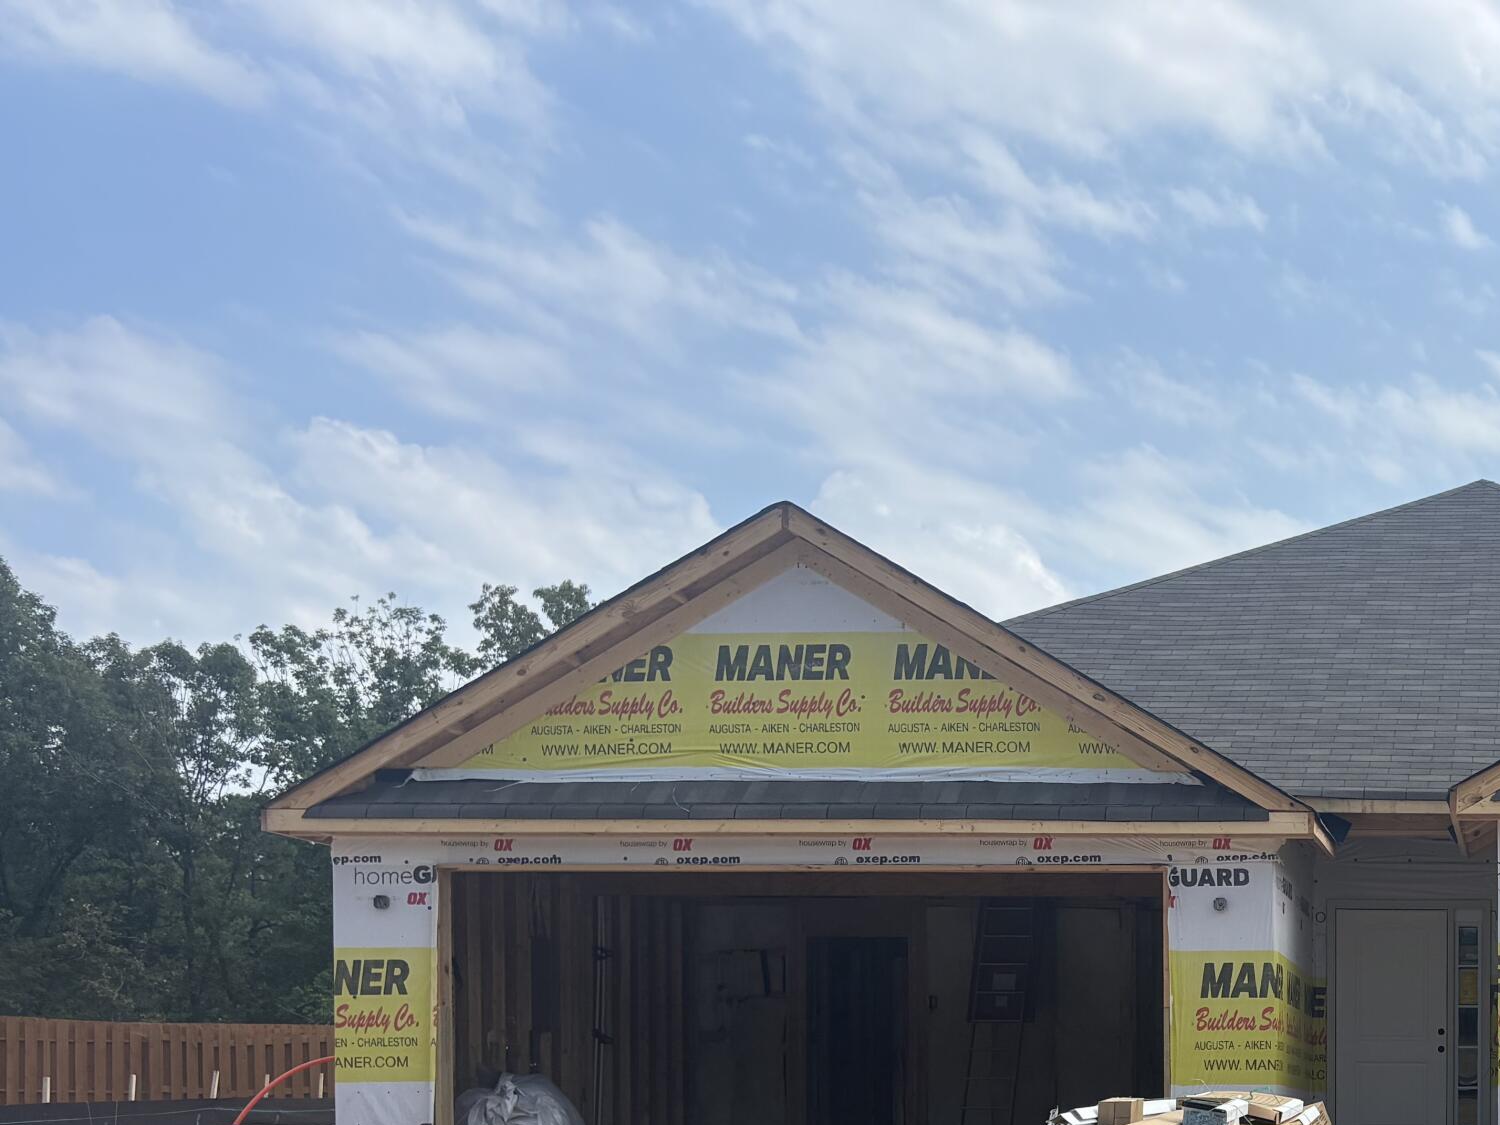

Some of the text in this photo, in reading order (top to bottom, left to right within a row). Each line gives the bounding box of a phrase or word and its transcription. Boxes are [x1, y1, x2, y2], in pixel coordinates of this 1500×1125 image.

[714, 643, 851, 682] MANER
[893, 643, 1000, 681] MAN
[598, 689, 683, 721] Supply Co.
[710, 688, 862, 720] Builders Supply Co.
[889, 688, 953, 714] Builders
[956, 688, 1012, 719] Supply
[530, 723, 681, 736] AUGUSTA AIKEN CHARLESTON
[709, 722, 860, 734] AUGUSTA AIKEN CHARLESTON
[888, 721, 1041, 733] AUGUSTA AIKEN CHARLESTON
[541, 742, 672, 756] WWW. MANER.COM
[719, 741, 851, 754] WWW. MANER.COM
[899, 741, 1031, 753] WWW. MANER.COM
[494, 838, 514, 852] OX
[673, 838, 694, 852] OX
[852, 837, 873, 851] OX
[1032, 837, 1054, 850] OX
[1212, 837, 1232, 850] OX
[498, 854, 562, 865] oxep.com
[676, 854, 741, 865] oxep.com
[856, 853, 921, 865] oxep.com
[1036, 853, 1102, 865] oxep.com
[407, 892, 427, 905] OX
[335, 1003, 420, 1035] Supply Co.
[1195, 1006, 1257, 1032] Builders
[357, 1037, 418, 1048] CHARLESTON
[1194, 1040, 1272, 1051] AUGUSTA AIKEN
[1204, 1059, 1242, 1071] WWW.
